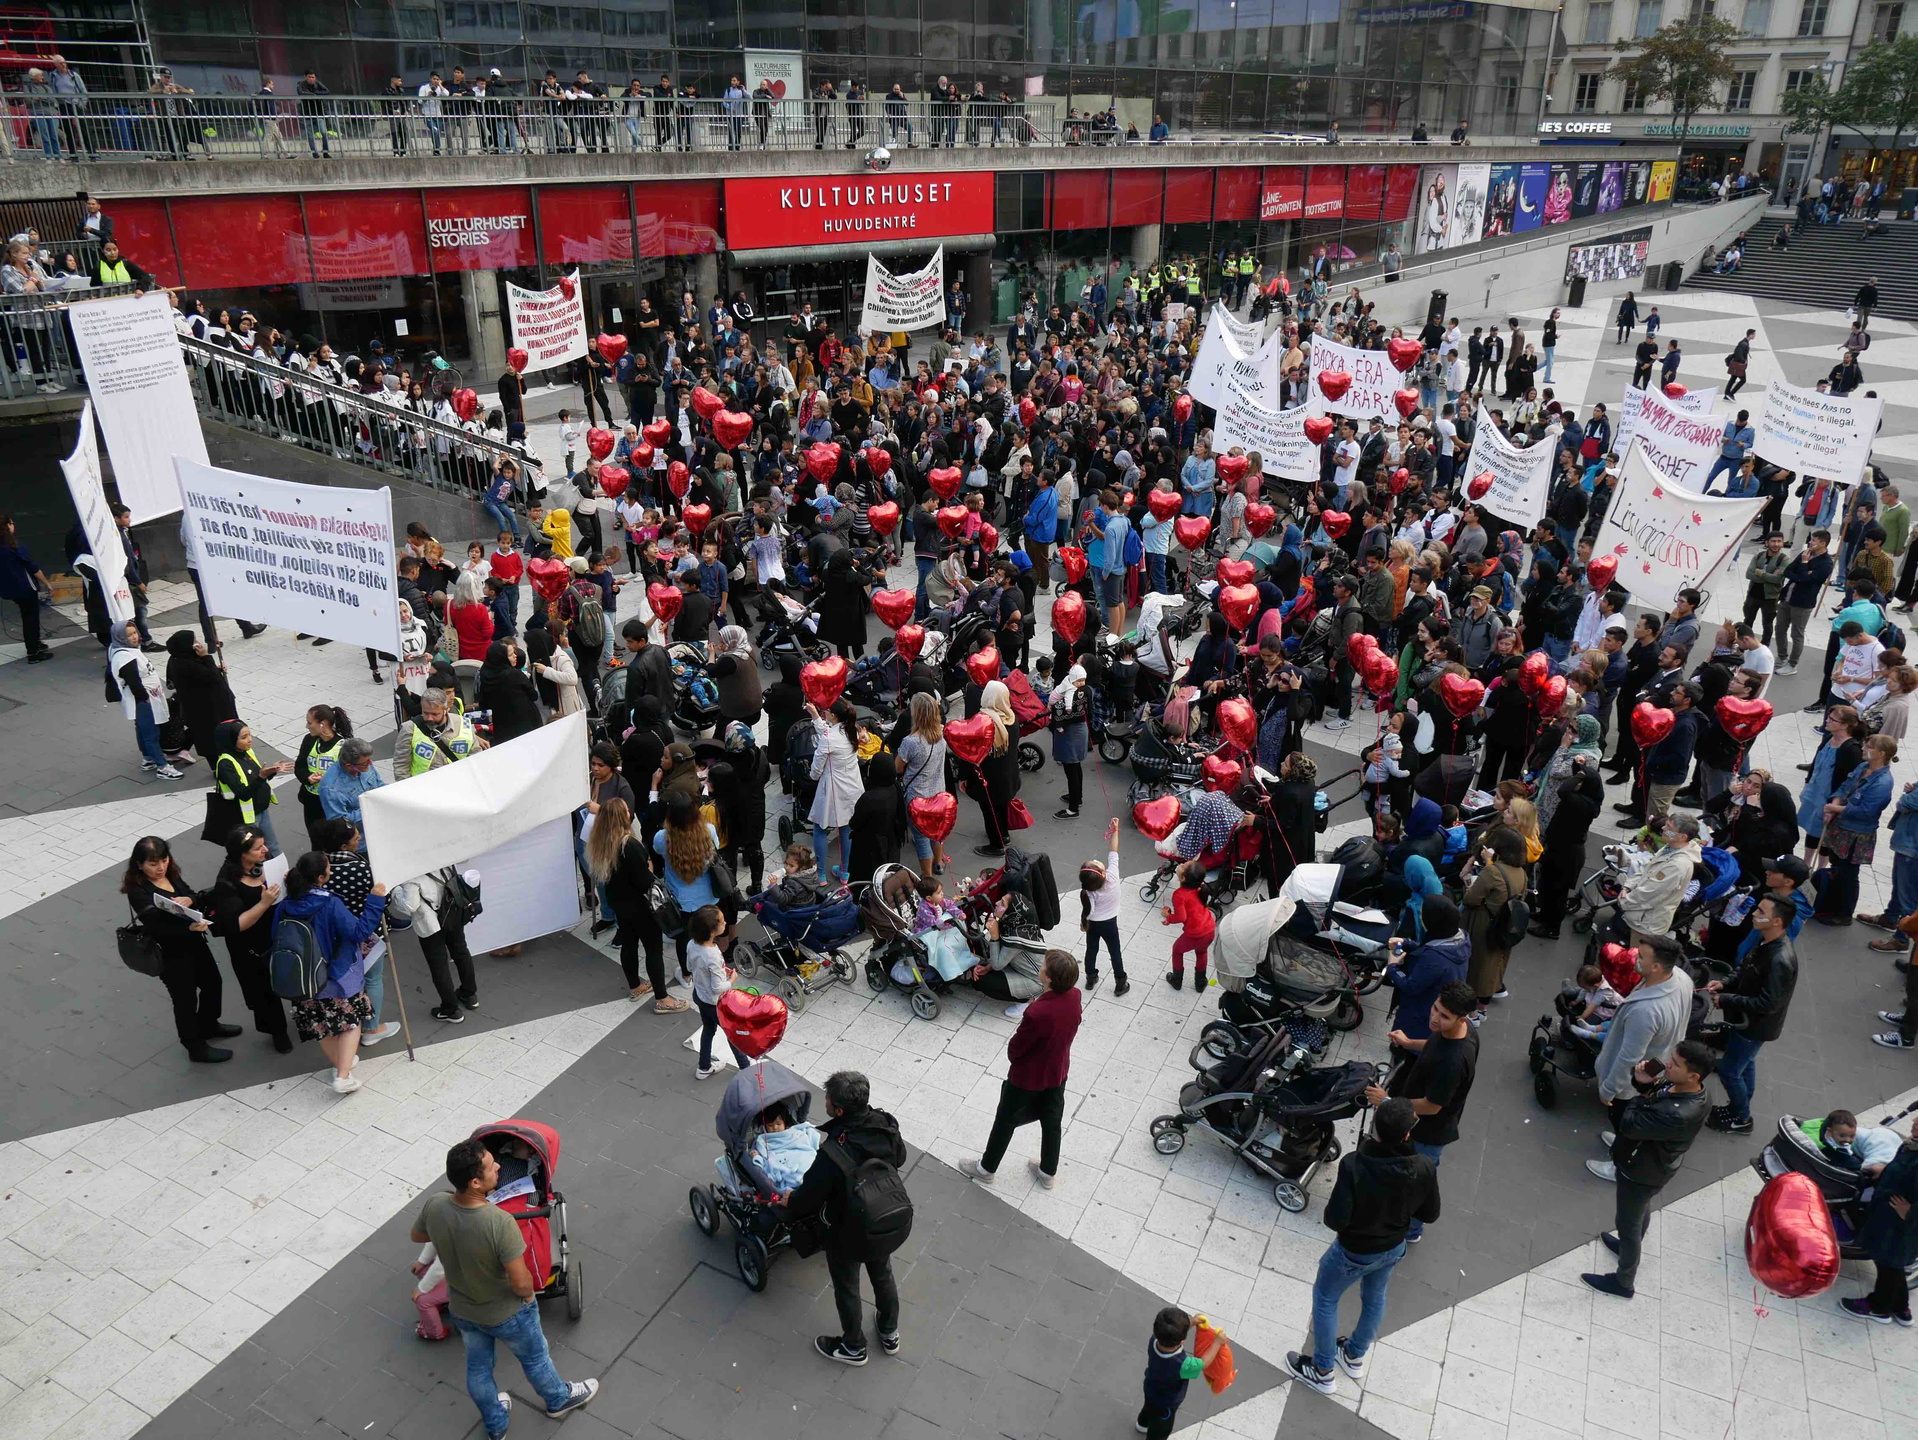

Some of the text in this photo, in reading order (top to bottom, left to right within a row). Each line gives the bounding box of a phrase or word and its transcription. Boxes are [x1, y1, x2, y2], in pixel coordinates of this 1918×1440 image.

[754, 62, 791, 70] KULTURHUSET
[1565, 122, 1611, 134] COFFEE
[1706, 125, 1751, 137] HOUSE
[781, 182, 952, 209] KULTURHUSET
[1261, 191, 1283, 206] LÅNE-
[1261, 199, 1302, 218] LABYRINTEN
[1304, 199, 1342, 216] TIOTRETTON
[428, 215, 527, 233] KULTURHUSET
[823, 212, 916, 233] HUVUDENTRÉ
[430, 231, 490, 248] STORIES
[887, 317, 900, 325] and
[1355, 359, 1384, 386] ERA
[1790, 394, 1802, 404] who
[1802, 398, 1820, 409] flees
[1821, 402, 1838, 413] has
[1839, 406, 1852, 415] no
[1792, 406, 1816, 420] human
[1826, 414, 1856, 428] illegal.
[1773, 417, 1785, 427] som
[1796, 426, 1808, 435] har
[1808, 430, 1830, 442] inget
[1831, 436, 1847, 447] val,
[1803, 441, 1811, 449] är
